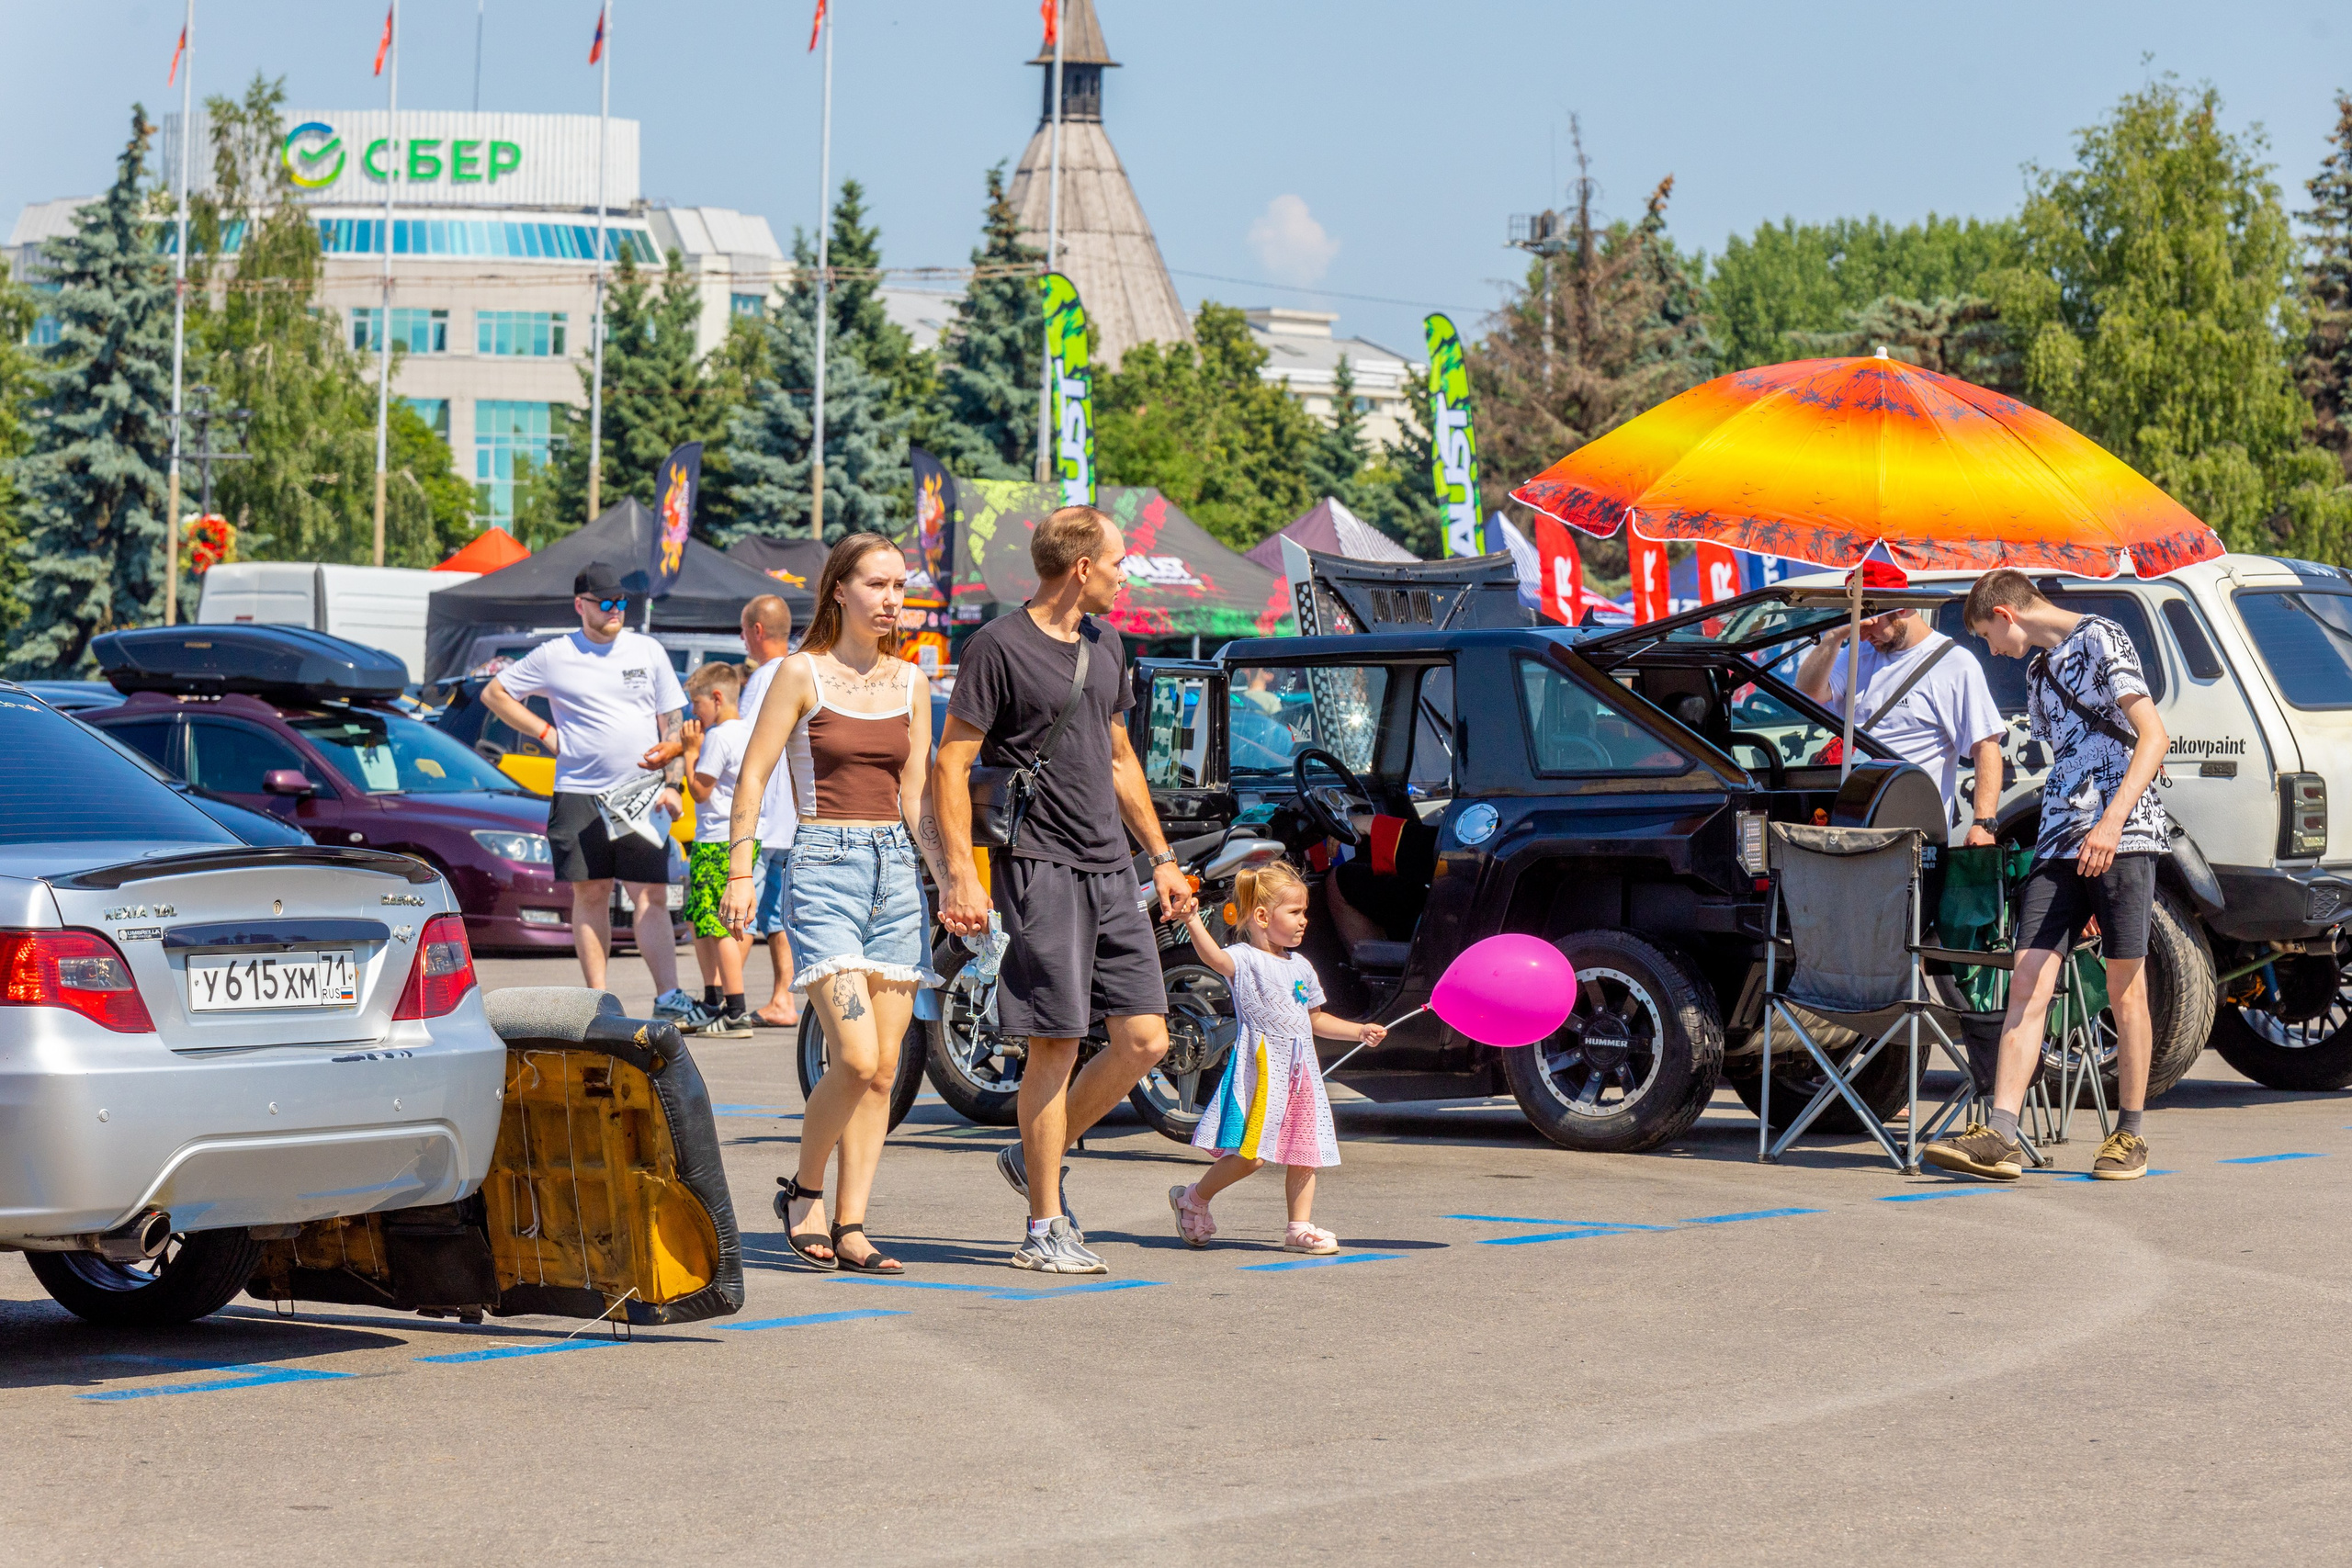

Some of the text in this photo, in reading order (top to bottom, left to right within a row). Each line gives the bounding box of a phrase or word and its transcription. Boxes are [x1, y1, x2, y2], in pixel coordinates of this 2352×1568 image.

[363, 138, 522, 184] СБЕР
[2166, 735, 2246, 759] akovpaint
[380, 894, 425, 908] DAEWOO
[103, 905, 148, 920] NEXIA
[127, 928, 161, 936] UMBRELLA
[321, 955, 346, 987] 71
[322, 987, 341, 1000] RUS
[1584, 1037, 1628, 1048] HUMMER
